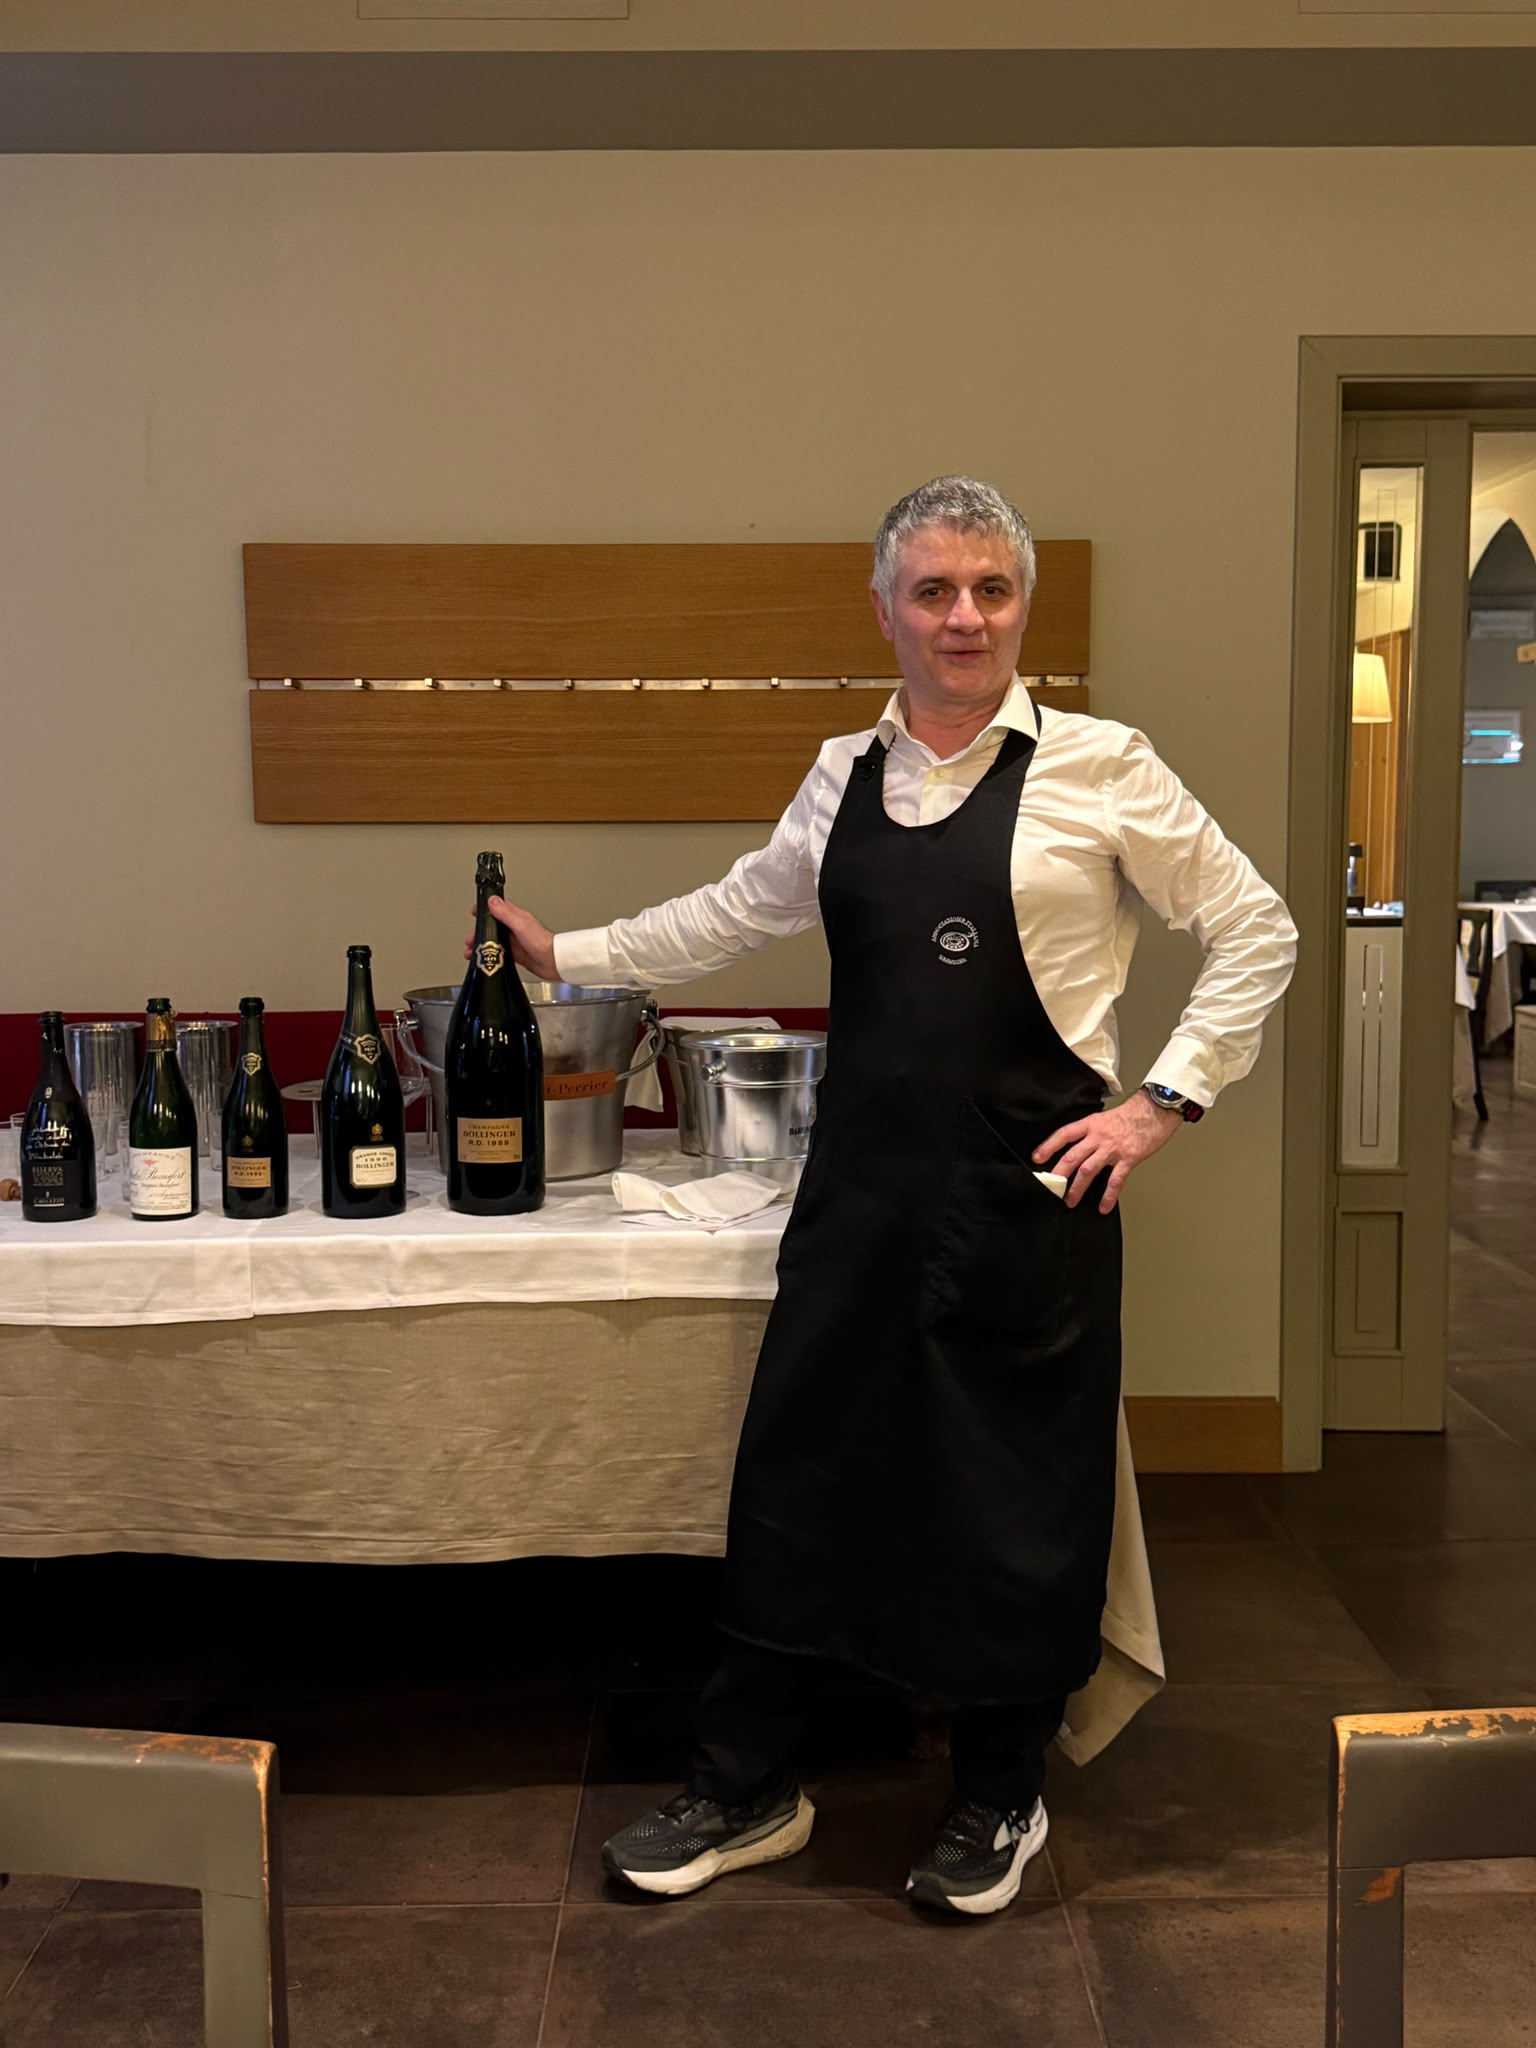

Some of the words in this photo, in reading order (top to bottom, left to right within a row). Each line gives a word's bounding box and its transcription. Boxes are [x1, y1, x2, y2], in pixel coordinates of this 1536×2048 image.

[546, 1080, 608, 1095] t-Perrier
[463, 1130, 516, 1138] BOLLINGER
[356, 1161, 394, 1169] BOLLINGER
